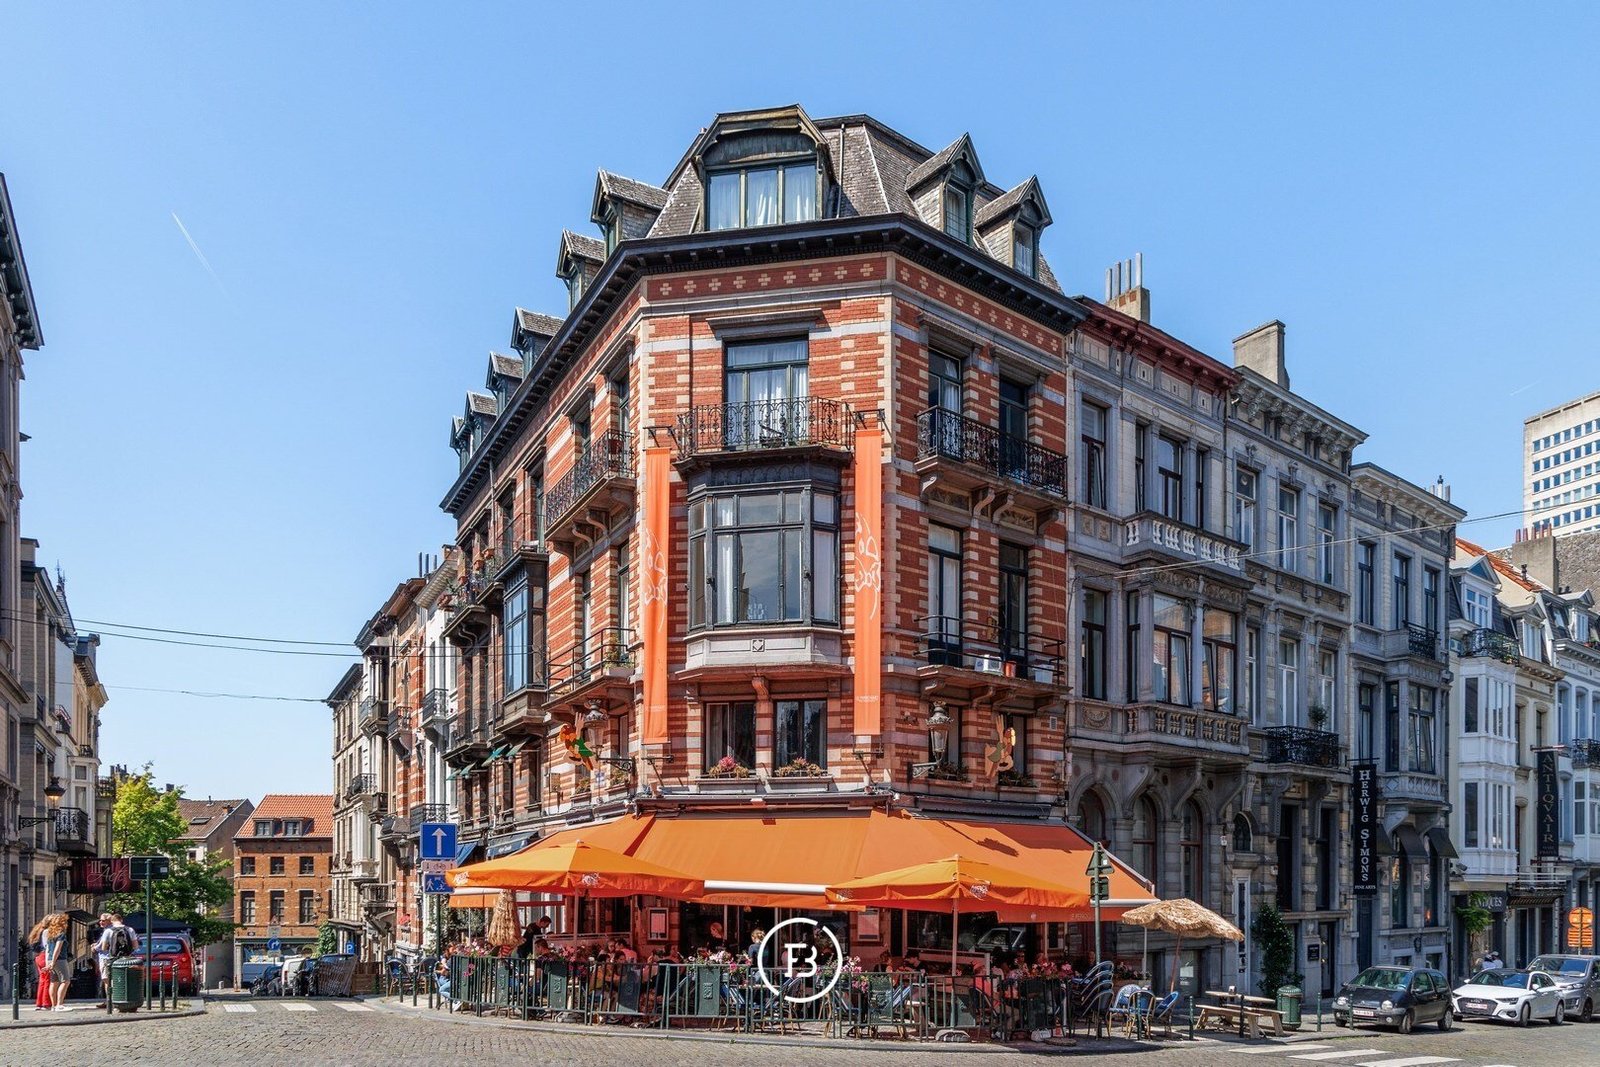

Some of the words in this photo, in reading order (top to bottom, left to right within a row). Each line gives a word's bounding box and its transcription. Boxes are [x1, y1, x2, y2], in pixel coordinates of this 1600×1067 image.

[1359, 770, 1371, 823] HERWIG
[1542, 754, 1554, 843] ANTIQVAIR
[1360, 828, 1370, 881] SIMONS
